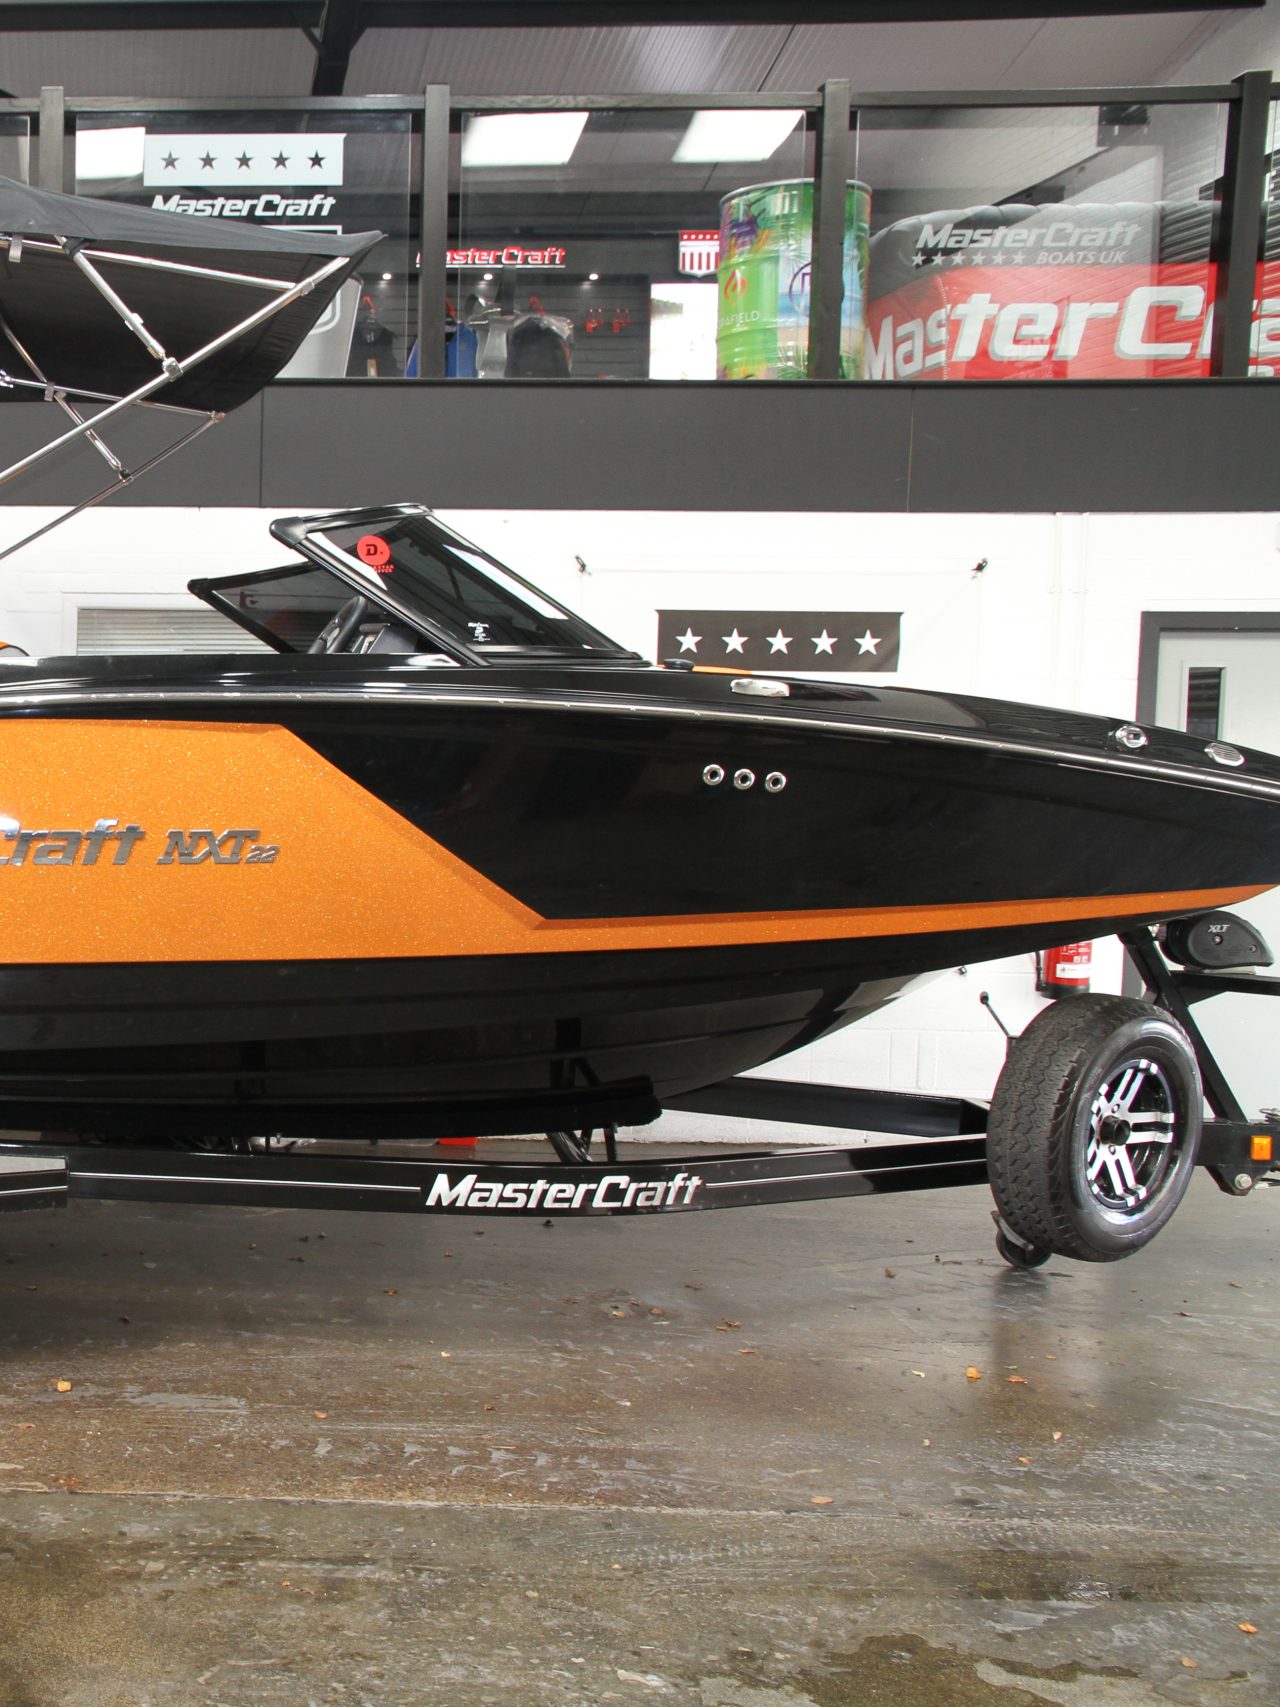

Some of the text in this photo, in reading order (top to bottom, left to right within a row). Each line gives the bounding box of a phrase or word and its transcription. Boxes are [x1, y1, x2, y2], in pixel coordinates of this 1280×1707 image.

[151, 193, 337, 217] MasterCraft
[915, 221, 1142, 249] MasterCraft
[416, 245, 566, 265] sterCraft
[1035, 250, 1130, 265] BOATS UK
[424, 1172, 703, 1209] MasterCraft
